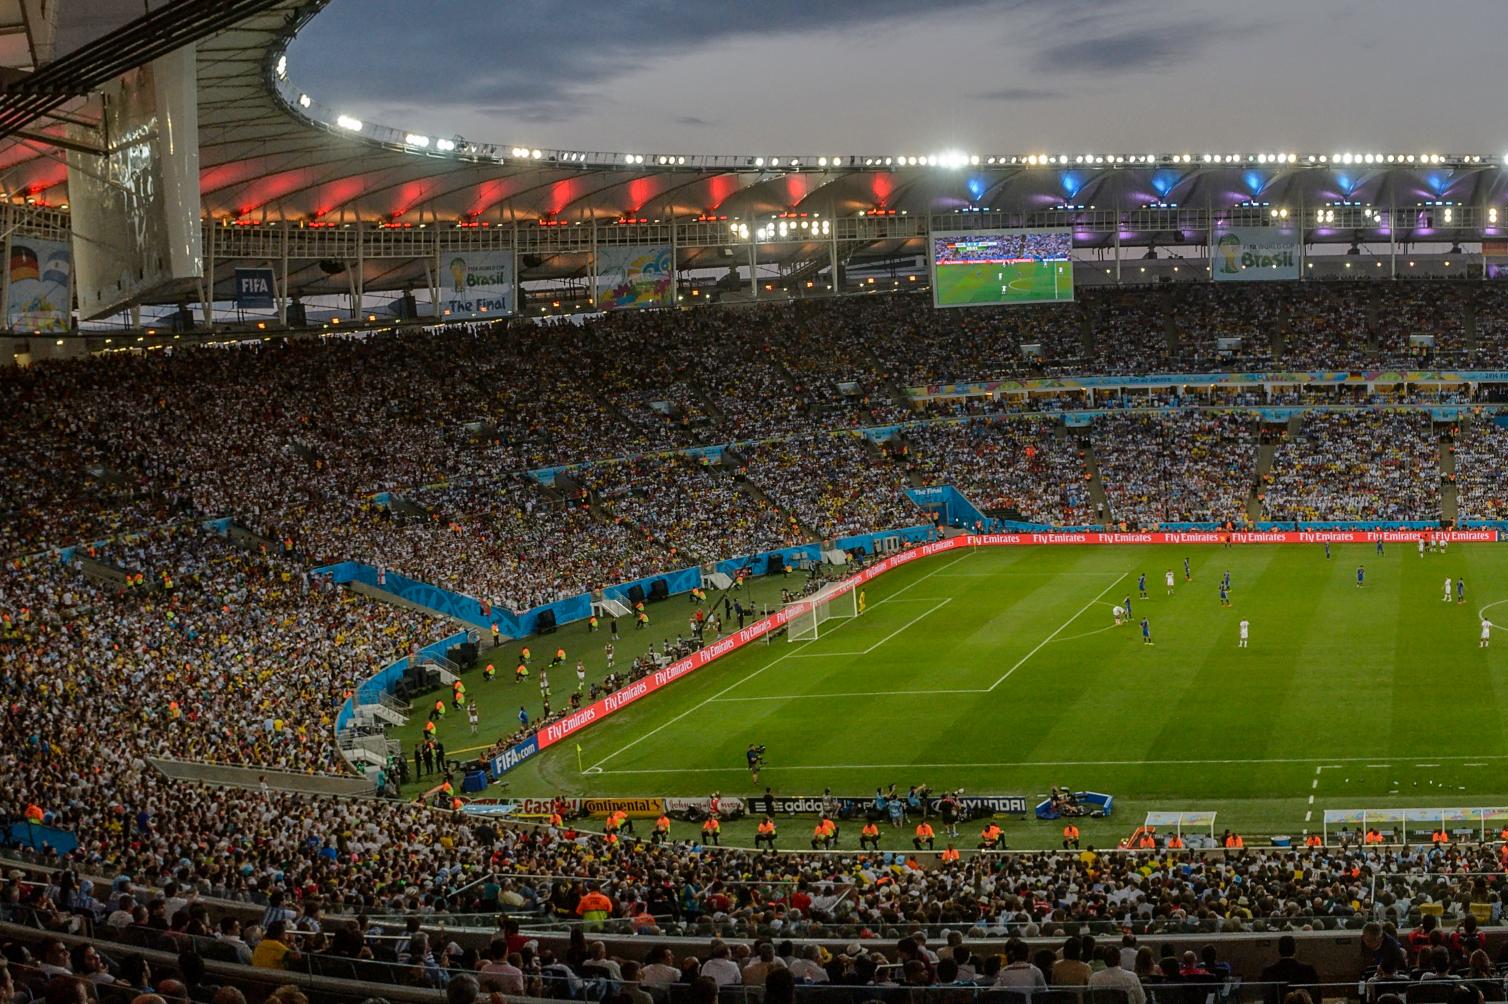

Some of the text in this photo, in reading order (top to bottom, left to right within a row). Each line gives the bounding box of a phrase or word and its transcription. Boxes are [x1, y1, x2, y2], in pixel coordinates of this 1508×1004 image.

[1242, 251, 1294, 268] Brasil
[242, 278, 268, 293] FIFA
[466, 272, 504, 287] Brasil
[449, 297, 505, 313] The Final
[967, 535, 1020, 545] Fly Emirates
[1033, 534, 1086, 543] Fly Emirates
[1099, 534, 1112, 543] Fly
[1165, 533, 1218, 543] Fly Emirates
[1232, 533, 1286, 542] Fly Emirates
[1299, 533, 1312, 542] Fly
[1367, 532, 1421, 541] Fly Emirates
[1435, 532, 1448, 541] Fly
[922, 539, 954, 555] Fly Emirates
[890, 550, 916, 566] Fly Emirates
[777, 610, 786, 623] Fly
[740, 619, 771, 642] Fly Emirates
[700, 637, 735, 662] Fly Emirates
[655, 659, 693, 686] Fly Emirates
[604, 681, 647, 711] Fly Emirates
[547, 707, 595, 741] Fly Emirates
[496, 743, 535, 774] FIFA.com
[524, 799, 577, 814] Castol
[584, 798, 651, 812] Continental
[785, 799, 826, 812] adida
